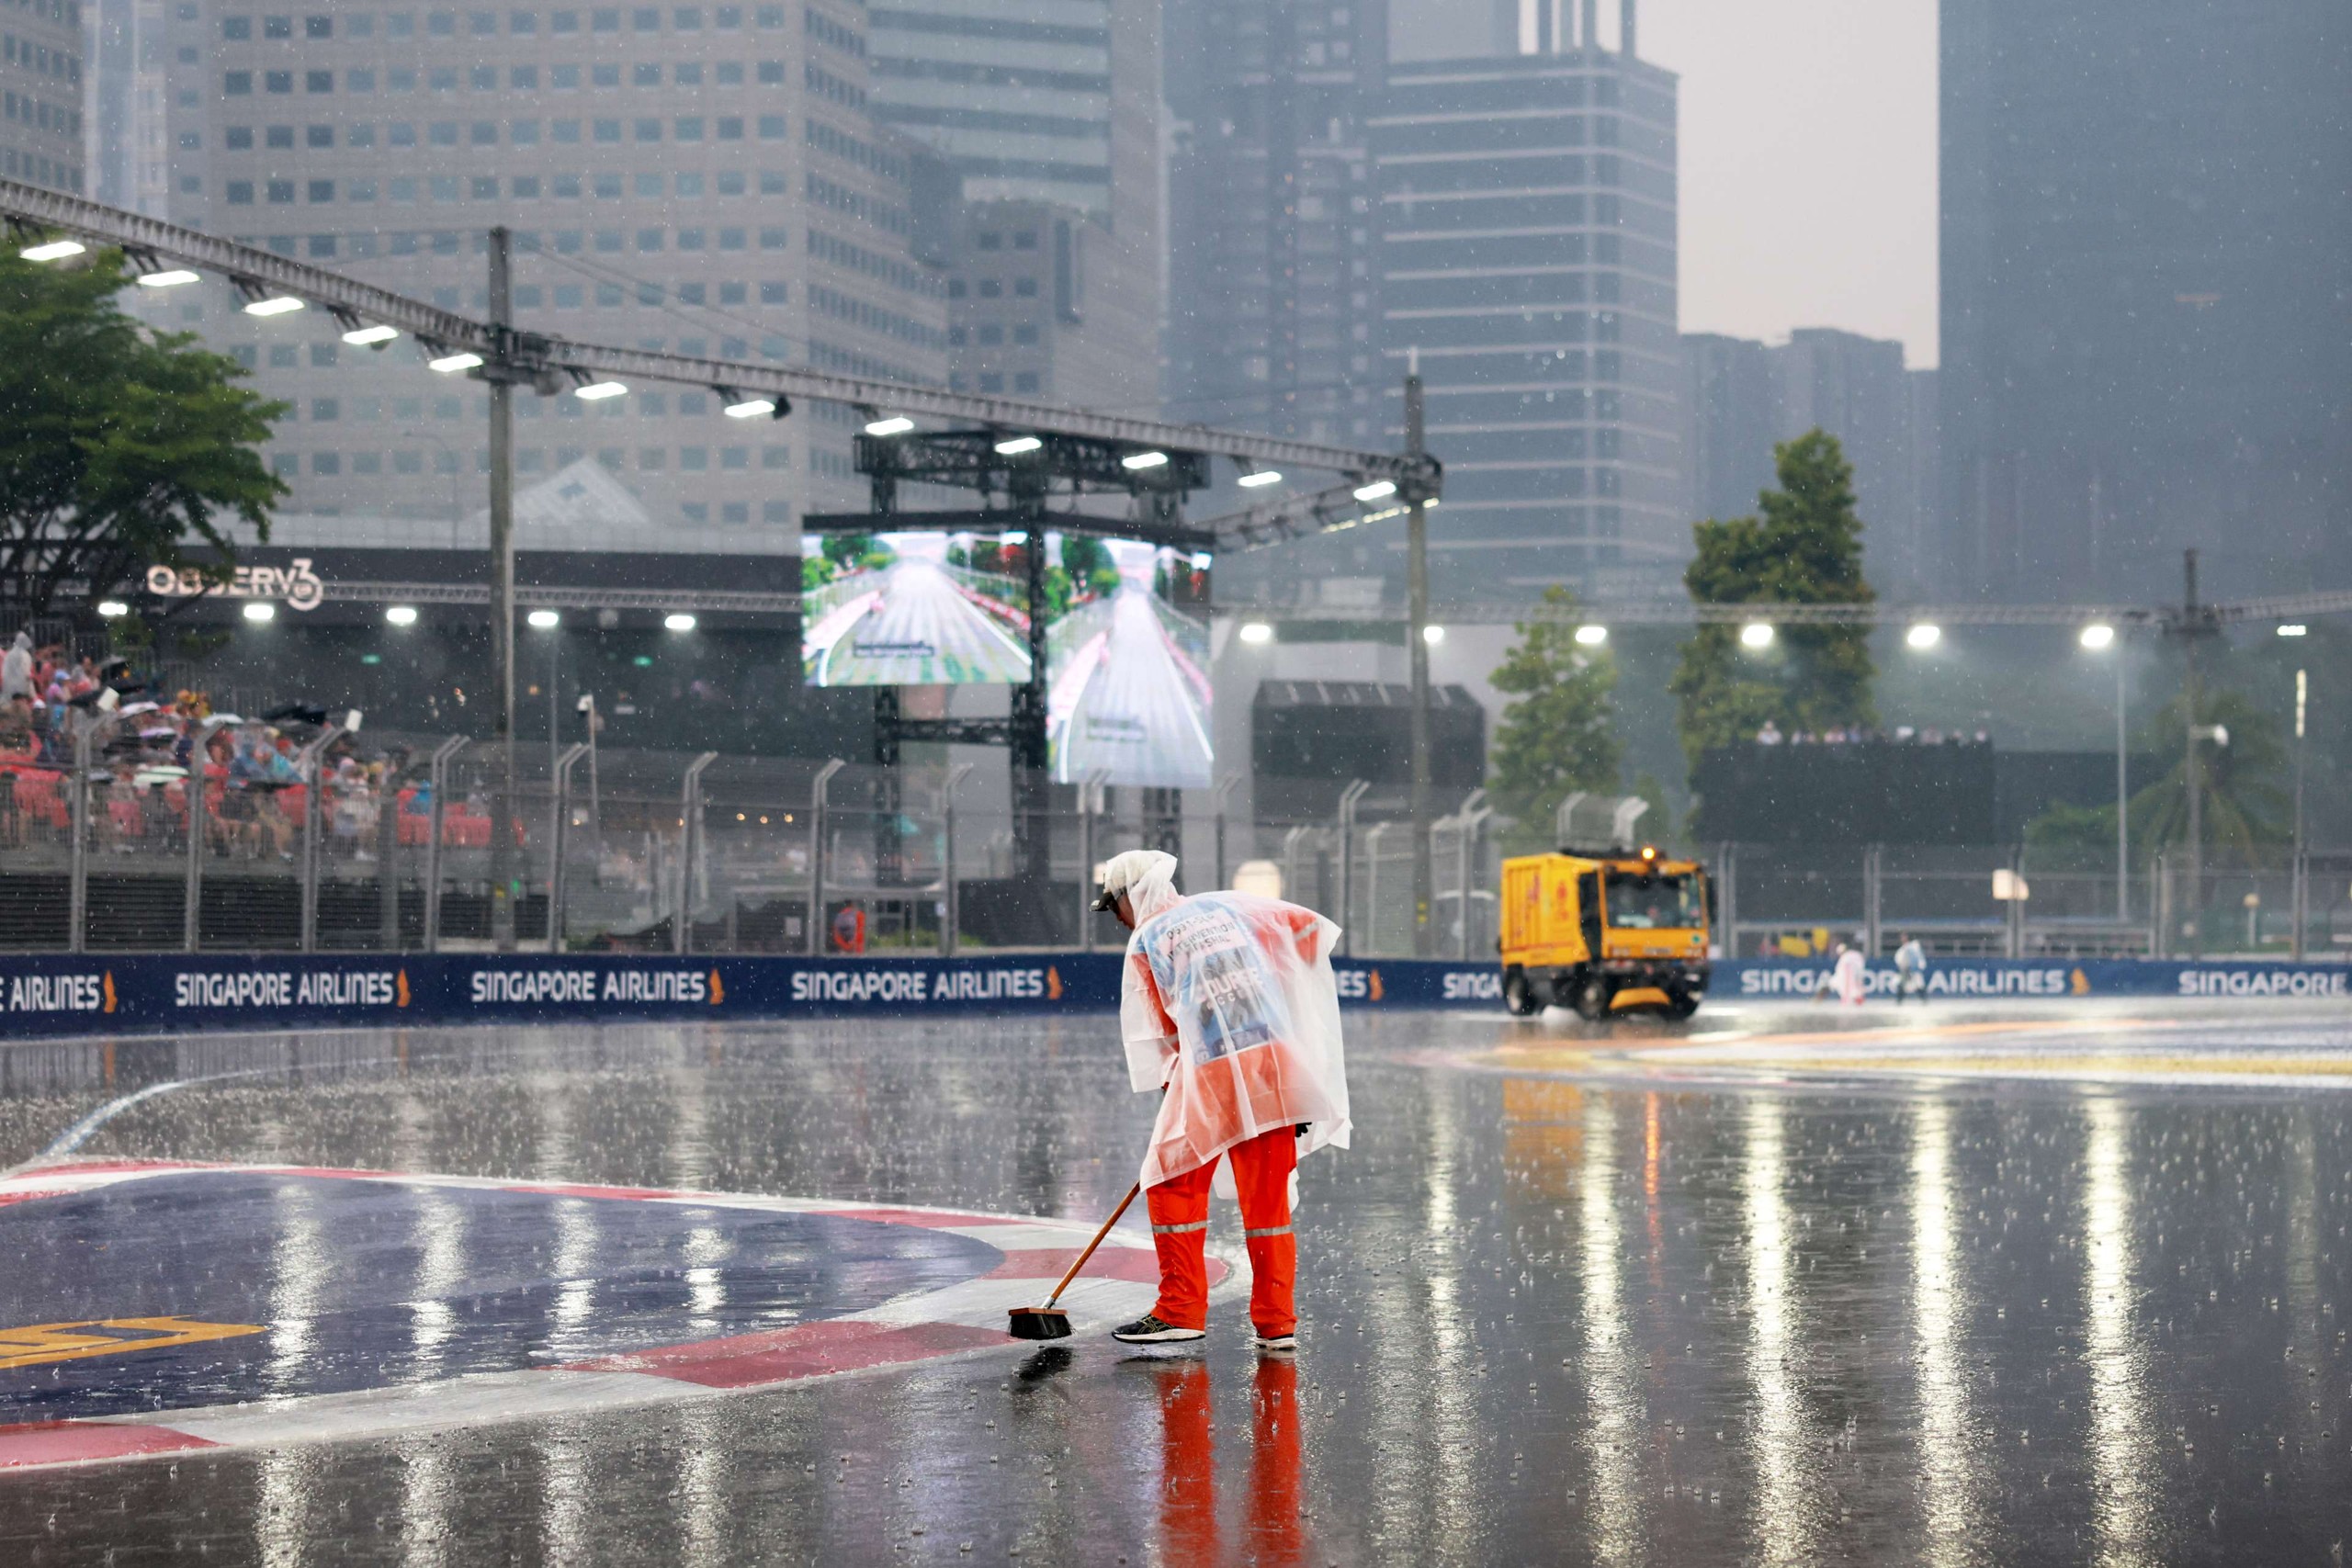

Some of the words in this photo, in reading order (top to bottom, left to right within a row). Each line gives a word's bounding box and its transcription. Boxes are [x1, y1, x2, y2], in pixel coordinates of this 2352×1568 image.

[9, 975, 100, 1011] AIRLINES
[175, 972, 292, 1007] SINGAPORE
[297, 972, 393, 1005] AIRLINES
[471, 971, 596, 1002] SINGAPORE
[603, 971, 706, 1001] AIRLINES
[791, 971, 927, 1000] SINGAPORE
[933, 969, 1044, 999] AIRLINES
[1443, 973, 1504, 998] SINGA
[1741, 969, 1924, 994] SINGAOR
[1928, 969, 2066, 995] AIRLINES
[2178, 970, 2347, 997] SINGAPORE
